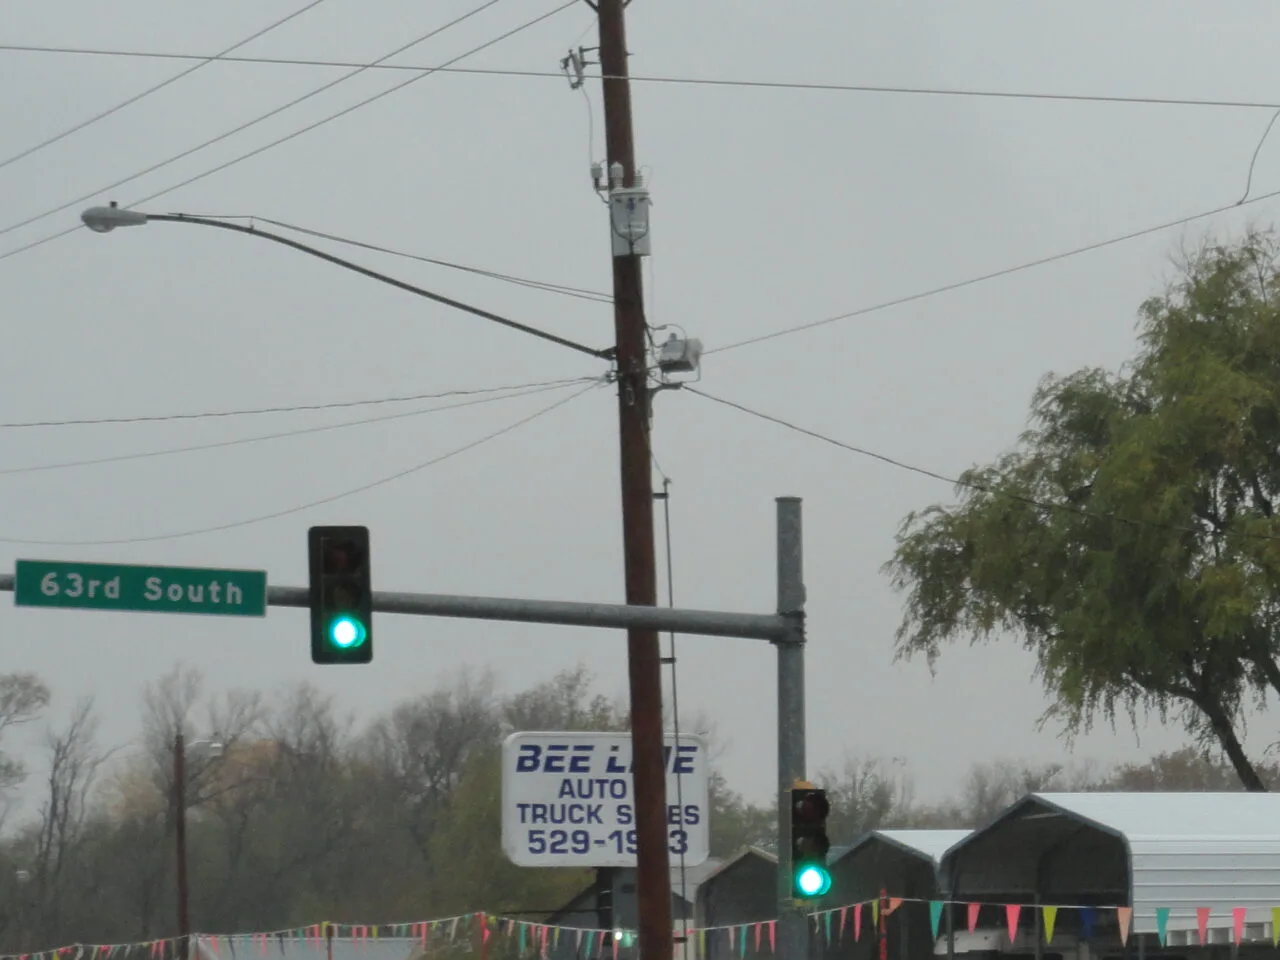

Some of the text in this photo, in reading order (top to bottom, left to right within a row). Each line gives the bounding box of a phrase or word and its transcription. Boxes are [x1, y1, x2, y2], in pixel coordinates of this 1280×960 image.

[41, 572, 243, 604] 63rd South
[516, 744, 699, 774] BEE LE
[558, 778, 627, 799] AUTO
[516, 803, 700, 825] TRUCK SES
[528, 829, 689, 854] 529-193
